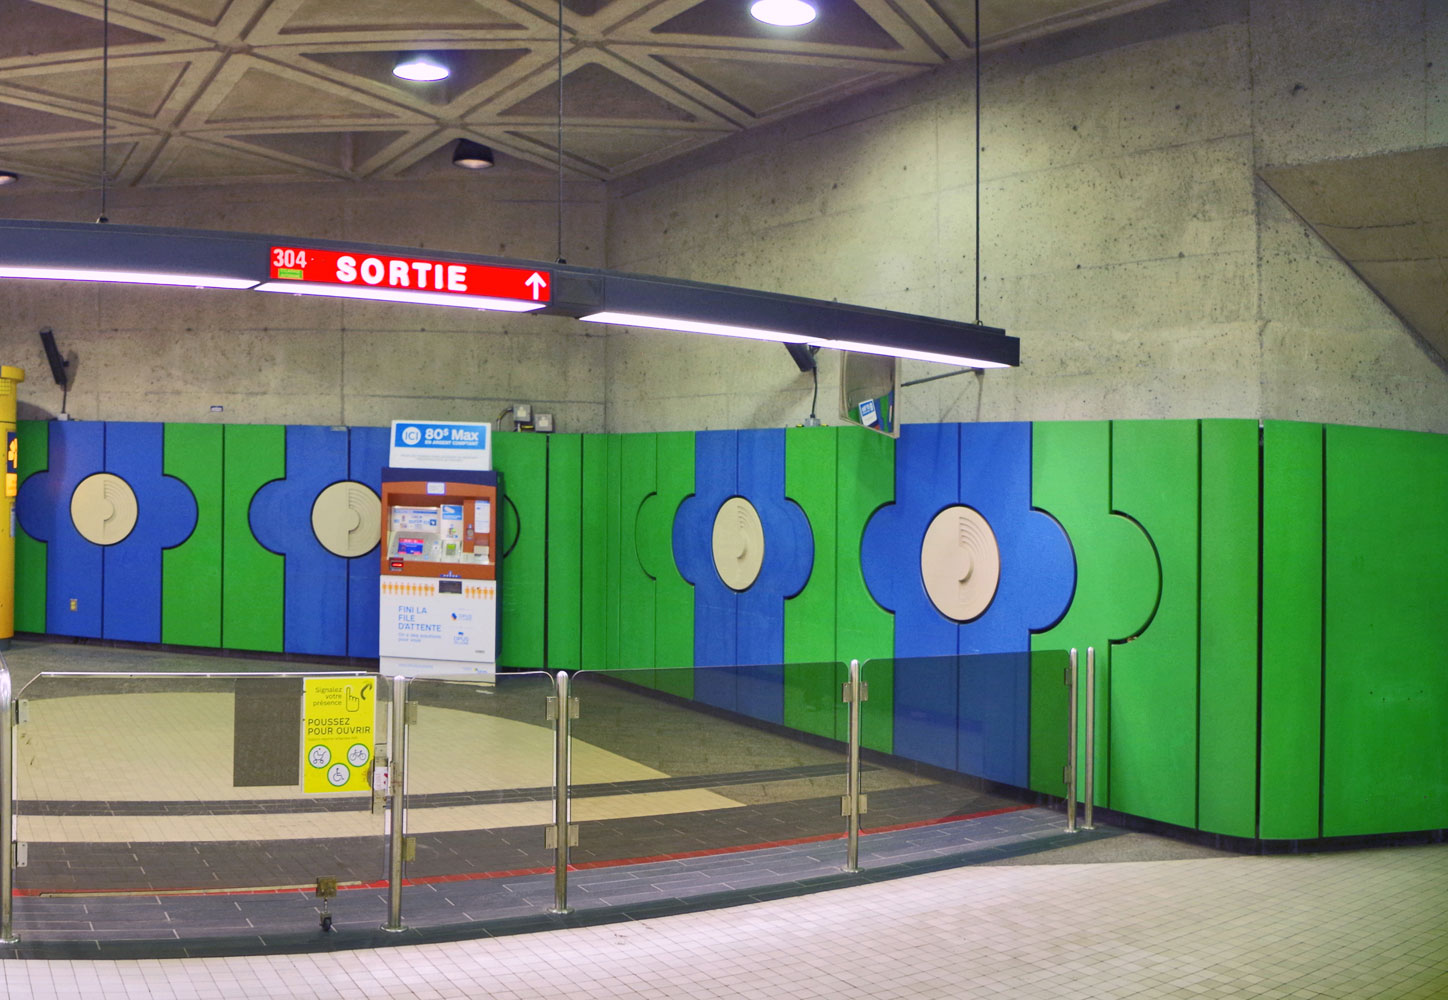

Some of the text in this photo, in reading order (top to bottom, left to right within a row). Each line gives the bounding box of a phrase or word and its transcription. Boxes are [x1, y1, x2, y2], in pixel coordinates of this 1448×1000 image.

[273, 248, 307, 268] 304
[336, 256, 467, 291] SORTIE
[405, 431, 419, 441] ICI
[451, 429, 479, 440] Max
[398, 605, 414, 613] FINI
[398, 614, 415, 622] FILE
[398, 622, 441, 632] D'ATTENTE
[308, 718, 350, 726] POUSSEZ
[308, 726, 371, 735] POUR OUVRIR
